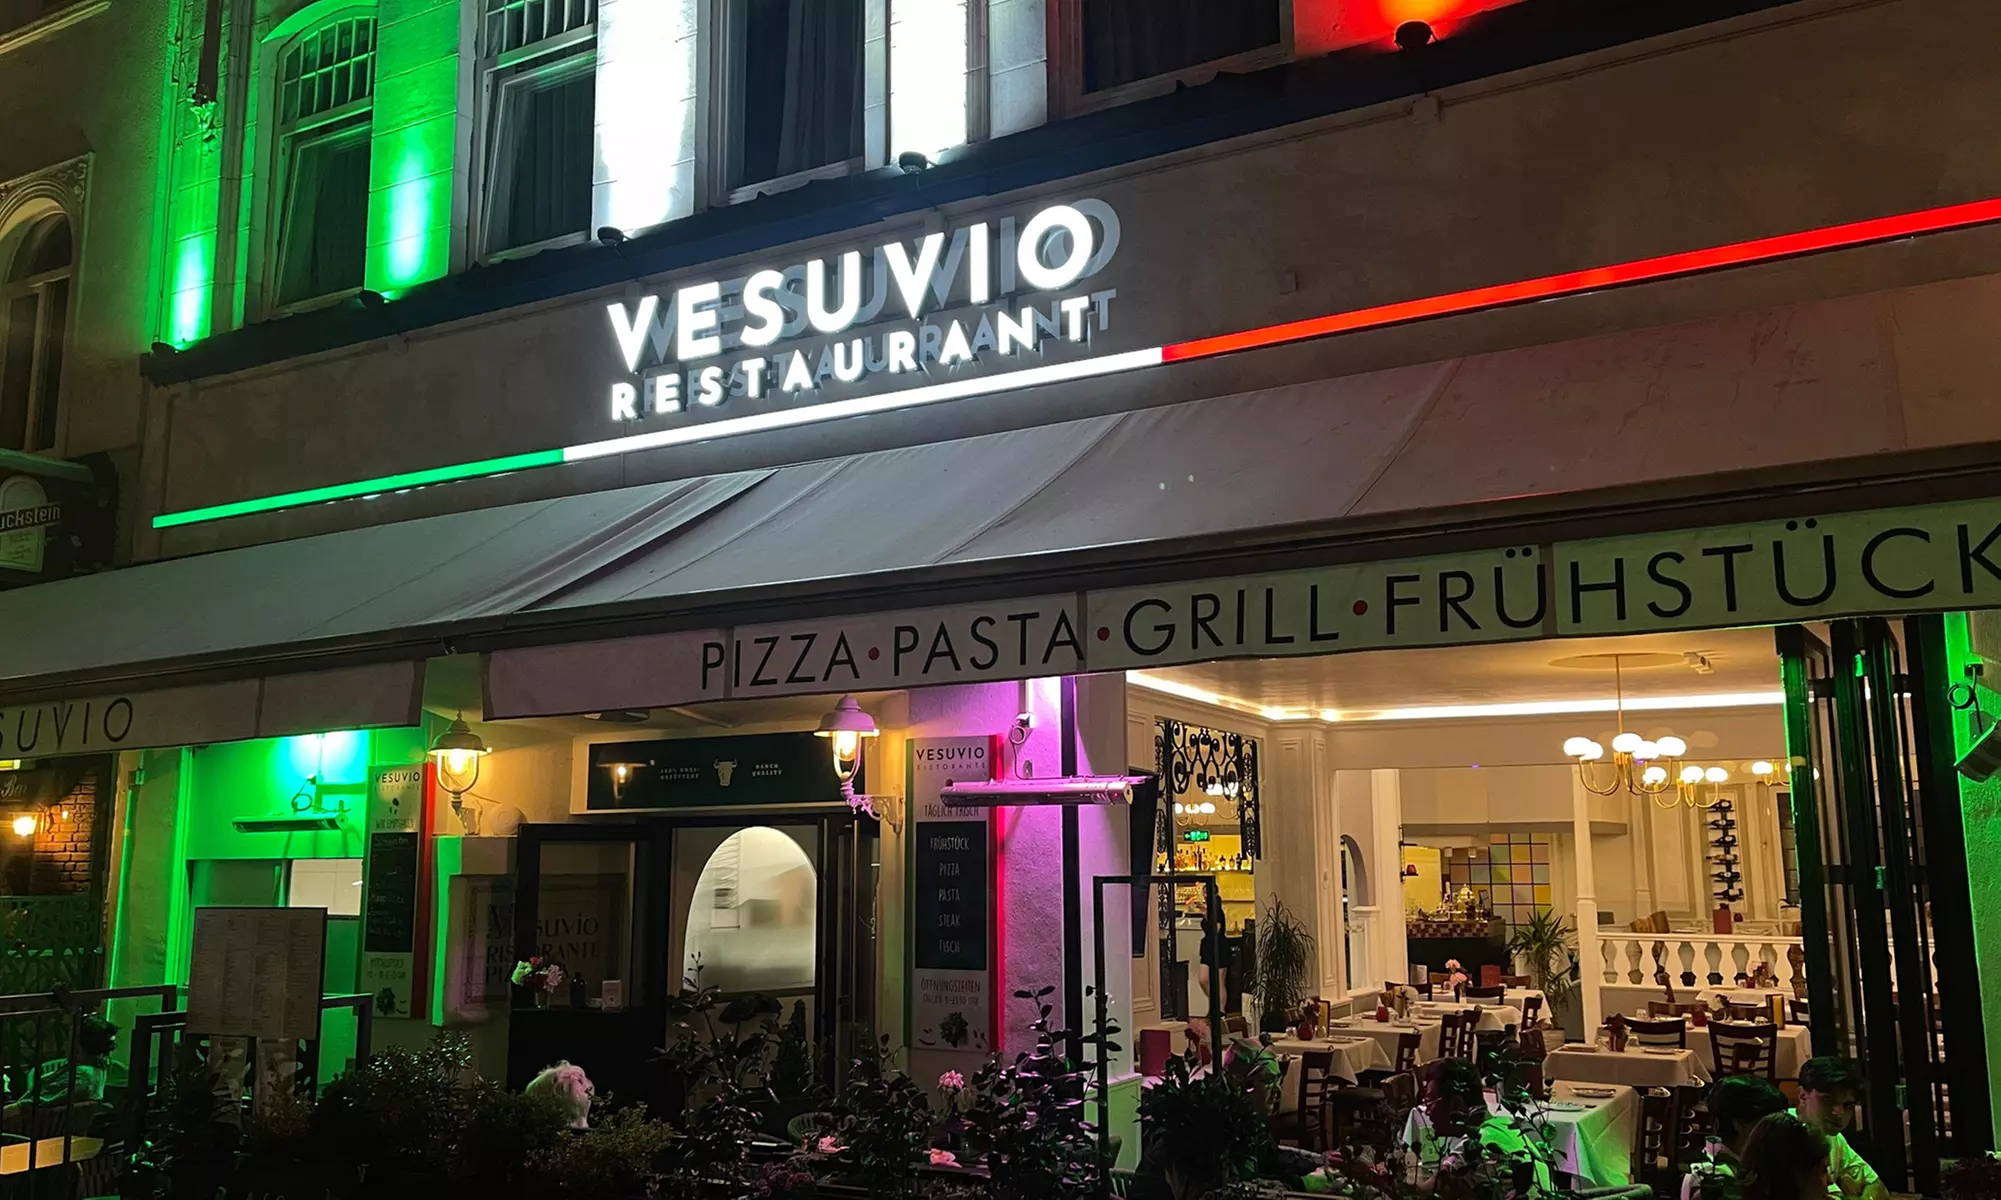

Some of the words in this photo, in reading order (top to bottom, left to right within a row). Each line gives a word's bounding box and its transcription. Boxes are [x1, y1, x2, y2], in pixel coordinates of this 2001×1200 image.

[606, 204, 1094, 373] VESUVIO
[611, 294, 1091, 421] RESTAURANT
[702, 630, 861, 690] PIZZA
[893, 608, 1085, 677] PASTA
[1122, 584, 1340, 656] GRILL
[1385, 518, 2001, 635] FRÜHSTÜCK
[0, 698, 133, 752] UVIO
[916, 747, 985, 760] VESUVIO
[916, 762, 985, 771] RISTORANTE
[374, 771, 421, 784] VESUVIO
[930, 835, 970, 851] FRÜHSTÜCK
[939, 862, 961, 876] PIZZA
[938, 888, 961, 902] PASTA
[938, 913, 961, 928] STEAK
[939, 939, 960, 953] FISCH
[920, 977, 981, 993] ÖFFNUNGSZEITEN
